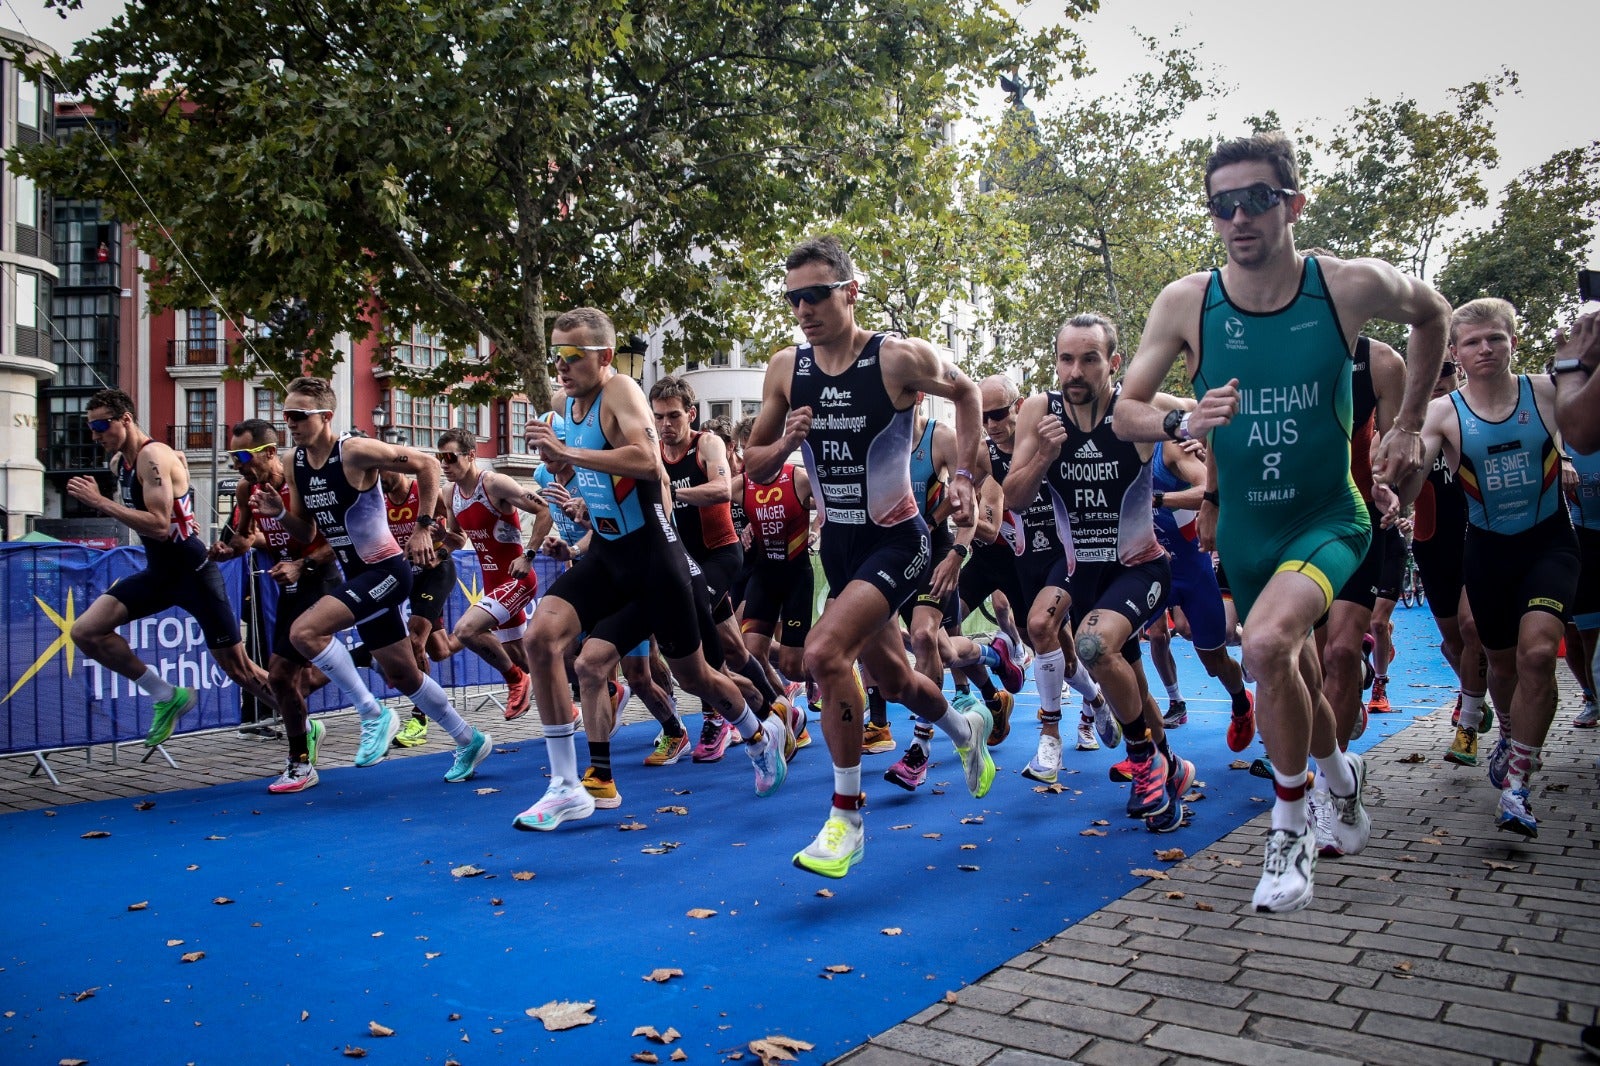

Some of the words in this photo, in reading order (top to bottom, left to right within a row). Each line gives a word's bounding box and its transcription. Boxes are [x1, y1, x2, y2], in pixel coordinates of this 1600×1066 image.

[820, 386, 852, 400] Metz
[819, 400, 852, 408] Triathlon
[810, 413, 867, 433] ueber-Moosbrugger
[1247, 419, 1299, 447] AUS
[822, 440, 853, 461] FRA
[1060, 461, 1119, 482] CHOQUERT
[1484, 459, 1501, 475] DE
[1501, 452, 1530, 471] SMET
[577, 471, 607, 488] BEL
[1486, 470, 1537, 491] BEL
[823, 485, 859, 496] Moselle
[1075, 489, 1108, 508] FRA
[1248, 488, 1296, 502] STEAMLAB
[316, 510, 337, 525] FRA
[761, 521, 783, 536] ESP
[269, 532, 291, 547] ESP
[397, 536, 410, 546] ES
[370, 577, 395, 598] Moselle
[502, 584, 527, 608] kiwami
[1087, 613, 1100, 627] 5
[113, 617, 206, 653] urop
[842, 708, 853, 722] 4
